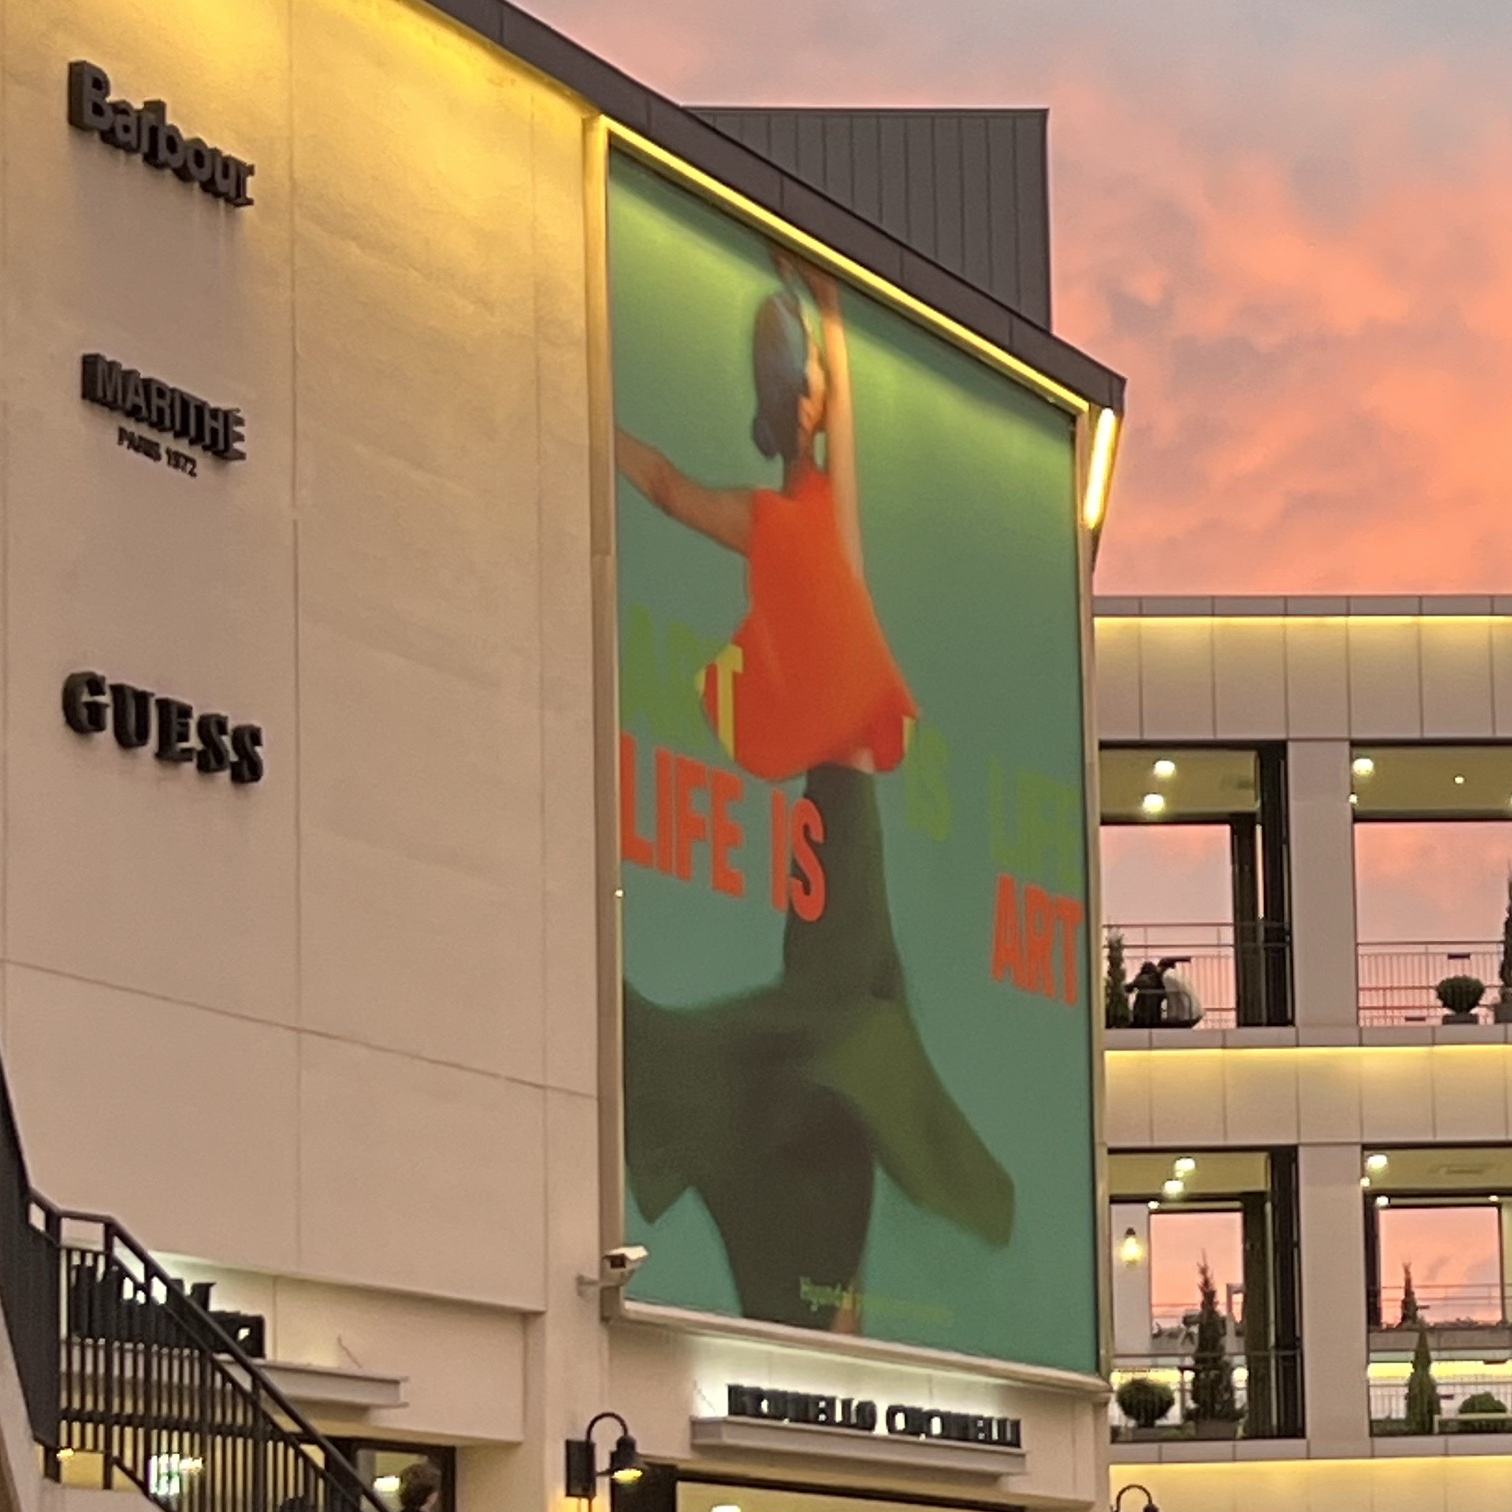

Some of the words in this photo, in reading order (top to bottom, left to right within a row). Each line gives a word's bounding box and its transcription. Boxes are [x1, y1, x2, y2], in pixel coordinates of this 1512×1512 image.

[68, 60, 255, 207] Barbour
[62, 671, 263, 784] GUESS
[621, 730, 744, 898] LIFE
[769, 788, 826, 922] IS
[991, 872, 1084, 1007] ART
